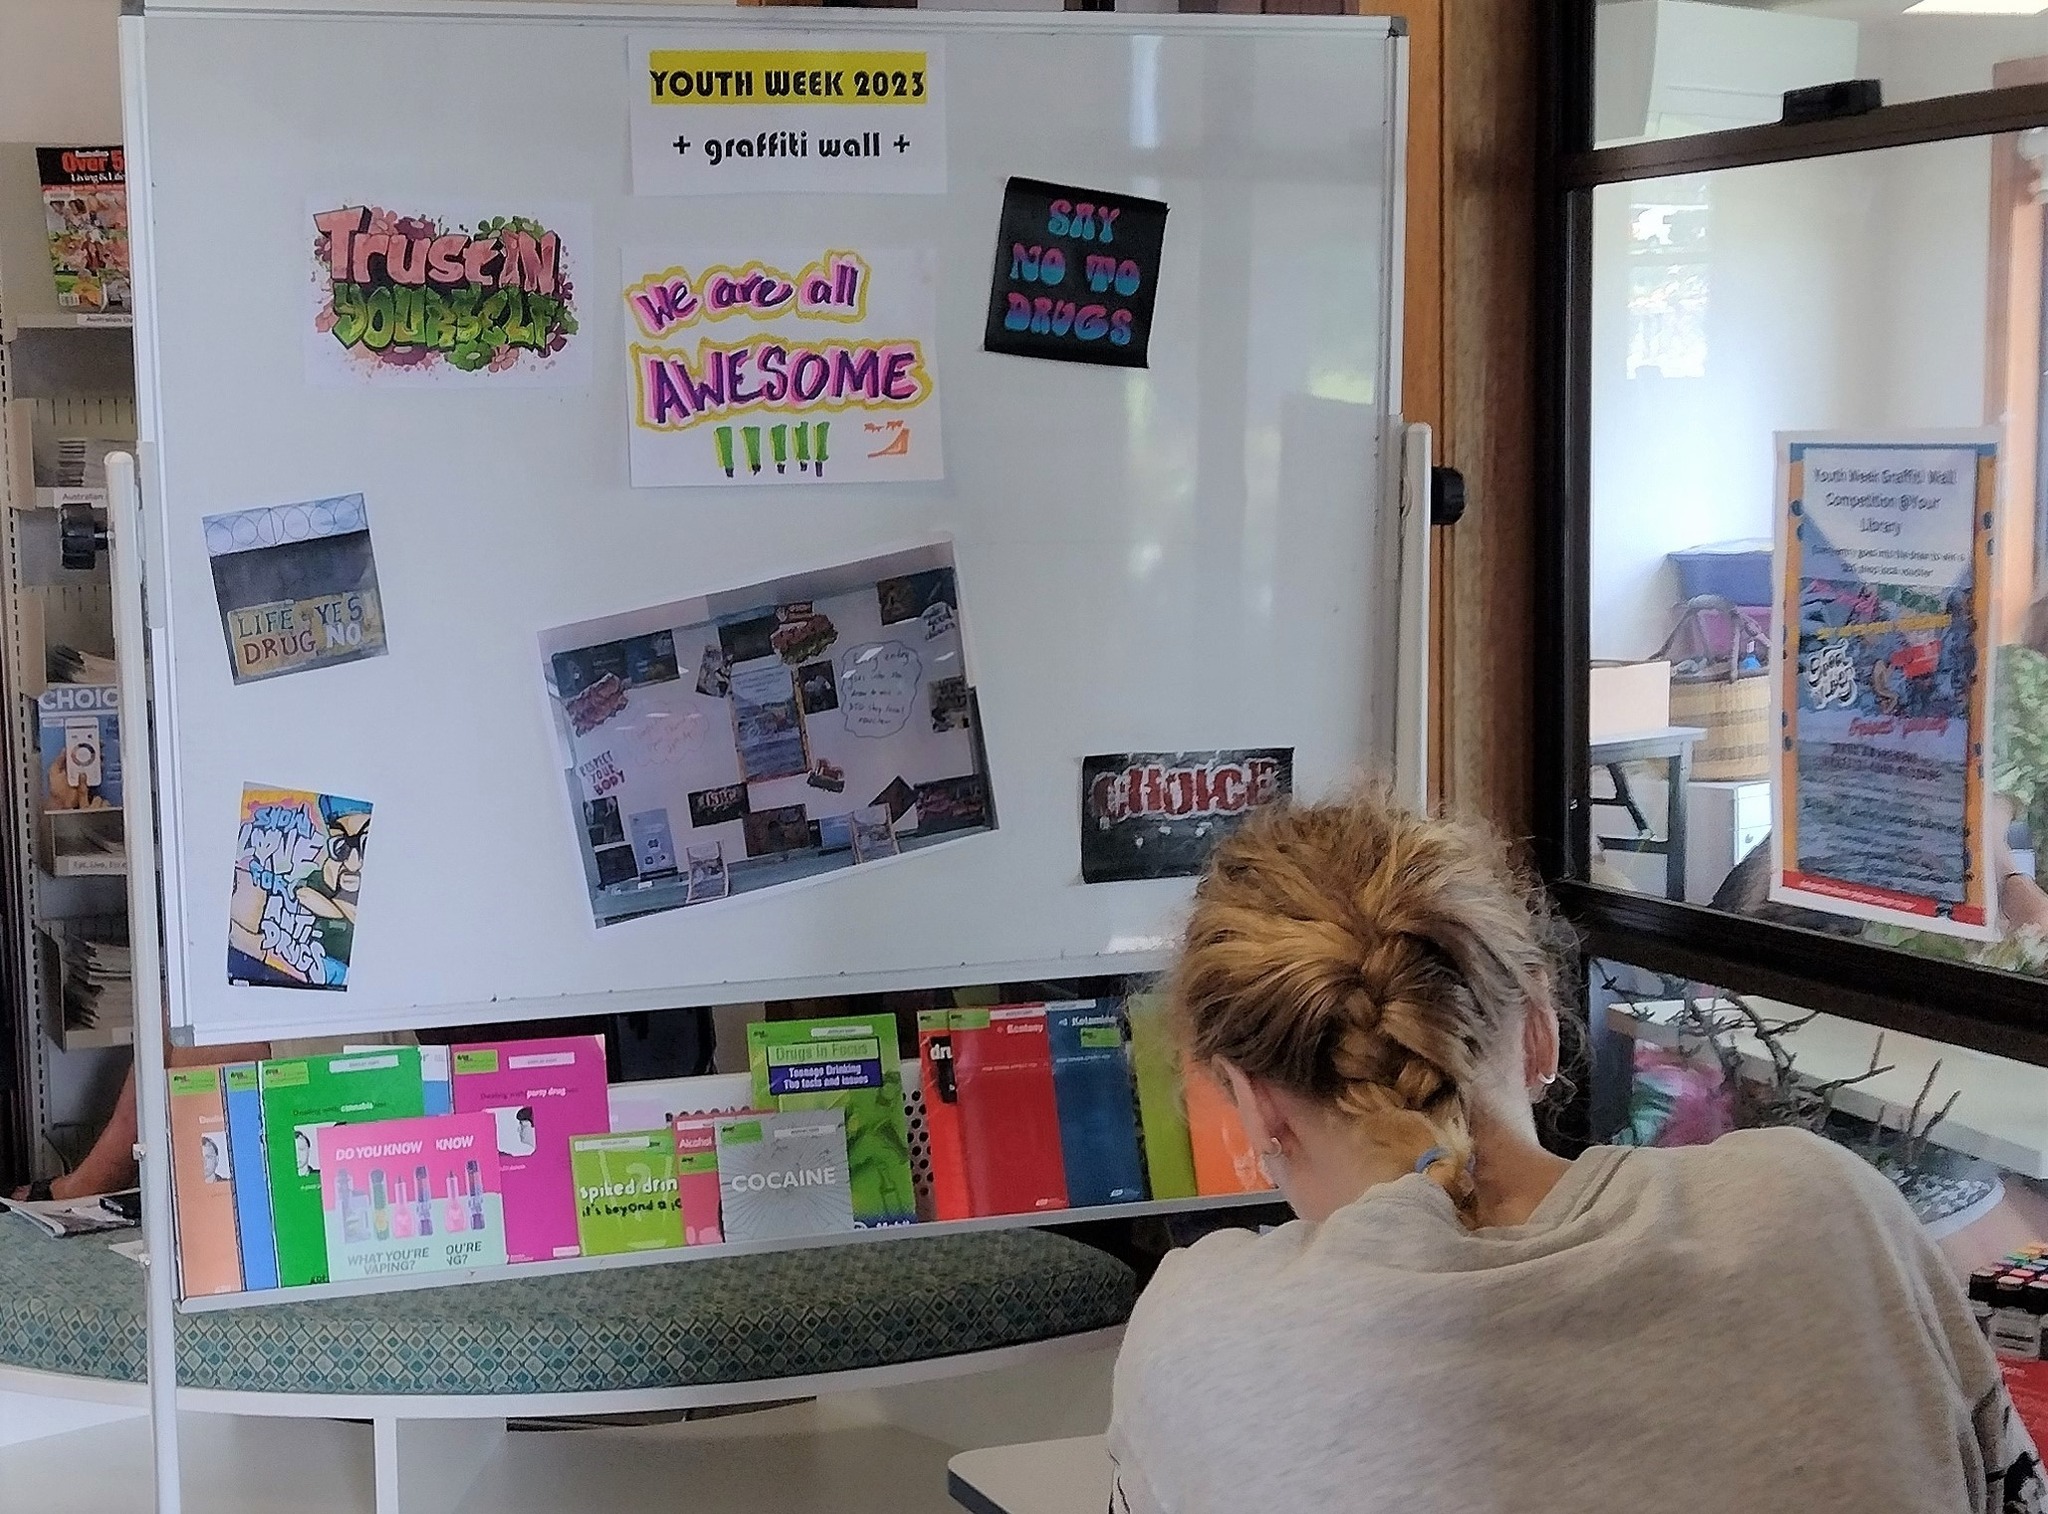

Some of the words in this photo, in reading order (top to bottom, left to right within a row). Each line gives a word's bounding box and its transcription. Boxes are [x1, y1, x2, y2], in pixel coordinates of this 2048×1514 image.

[650, 71, 753, 97] YOUTH
[765, 71, 844, 97] WEEK
[853, 71, 925, 97] 2023
[704, 131, 808, 165] graffiti
[818, 133, 881, 157] wall
[1048, 199, 1121, 243] SAY
[313, 205, 497, 286] Trust
[707, 271, 796, 313] are
[801, 253, 860, 308] all
[1009, 242, 1066, 286] NO
[1085, 254, 1141, 297] TO
[1004, 292, 1133, 346] DRUGS
[641, 344, 920, 425] AWESOME
[236, 608, 294, 639] LIFE
[313, 596, 363, 625] YES
[242, 629, 317, 665] DRUG
[325, 622, 363, 649] NO
[593, 769, 625, 796] BODY
[260, 918, 327, 986] DRUGS
[823, 1075, 840, 1087] and
[335, 1147, 355, 1160] DO
[355, 1144, 382, 1159] YOU
[381, 1140, 422, 1157] KNOW
[435, 1134, 474, 1150] KNOW
[580, 1178, 636, 1203] spiked
[731, 1166, 837, 1192] COCAINE
[582, 1202, 602, 1218] it's
[605, 1199, 653, 1217] beyond
[657, 1200, 668, 1210] a
[347, 1251, 384, 1267] WHAT
[384, 1247, 430, 1263] YOU'RE
[446, 1240, 483, 1255] OU'RE
[363, 1260, 416, 1275] VAPING?
